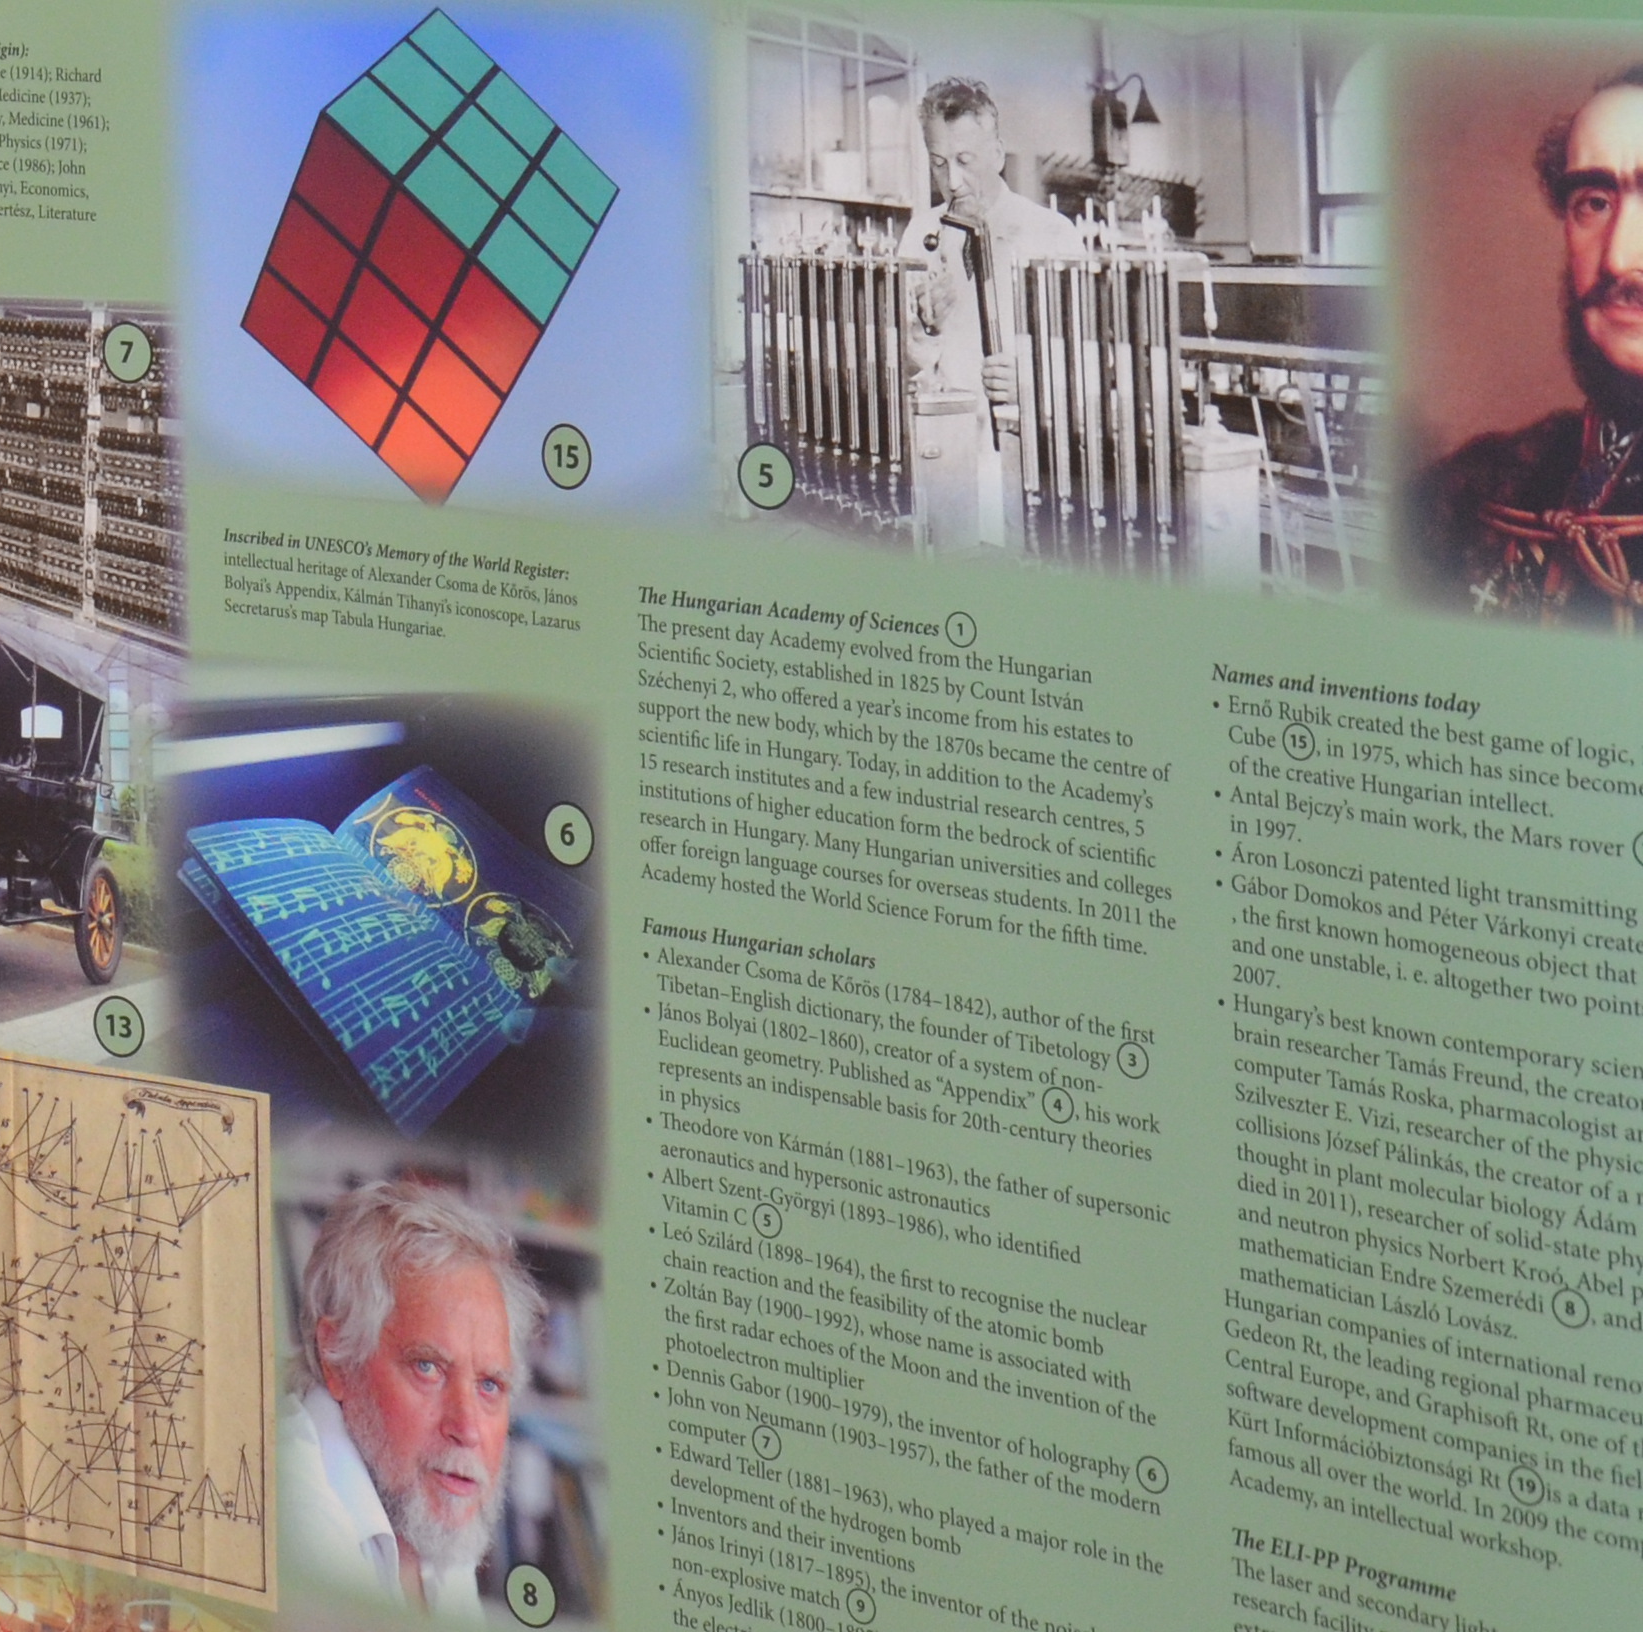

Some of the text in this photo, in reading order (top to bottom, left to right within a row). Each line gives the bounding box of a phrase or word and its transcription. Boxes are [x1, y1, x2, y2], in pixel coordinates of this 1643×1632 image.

[120, 340, 134, 364] 7
[553, 443, 579, 469] 15
[758, 463, 774, 488] 5
[223, 527, 285, 548] Inscribed
[287, 534, 301, 550] in
[375, 543, 431, 568] Memory
[432, 550, 446, 570] of
[448, 551, 469, 568] the
[473, 554, 511, 573] World
[513, 558, 570, 581] Register:
[223, 551, 294, 573] intellectual
[297, 557, 349, 583] heritage
[351, 563, 364, 580] of
[367, 565, 432, 588] Alexander
[435, 574, 479, 594] Csoma
[481, 578, 497, 596] de
[544, 587, 578, 607] János
[275, 580, 341, 603] Appendix,
[344, 586, 393, 608] Kálmán
[455, 601, 528, 628] iconoscope,
[531, 610, 581, 632] Lazarus
[300, 609, 329, 628] map
[331, 609, 374, 629] Tabula
[378, 614, 446, 639] Hungariae.
[638, 586, 667, 606] The
[670, 589, 762, 618] Hungarian
[766, 600, 846, 631] Academy
[848, 609, 867, 634] of
[869, 611, 940, 637] Sciences
[637, 612, 1092, 685] The present day Academy evolved from the Hungarian
[638, 640, 1084, 712] Scientific Society, established in 1825 by Count István
[1211, 663, 1481, 720] Names and inventions today
[1278, 700, 1333, 730] Rubik
[1337, 714, 1404, 737] created
[1409, 717, 1440, 742] the
[1446, 721, 1485, 748] best
[1490, 734, 1545, 755] game
[1550, 737, 1570, 758] of
[1577, 738, 1635, 768] logic,
[560, 822, 575, 847] 6
[1229, 785, 1279, 809] Antal
[1360, 807, 1407, 830] main
[1412, 814, 1468, 839] work,
[1473, 819, 1505, 842] the
[1511, 824, 1563, 850] Mars
[1568, 837, 1625, 858] rover
[642, 916, 876, 970] Famous Hungarian scholars
[657, 947, 741, 976] Alexander
[745, 959, 803, 987] Csoma
[807, 969, 827, 990] de
[1001, 1004, 1062, 1029] author
[1065, 1013, 1084, 1034] of
[1087, 1015, 1117, 1038] the
[1120, 1020, 1156, 1048] first
[105, 1014, 132, 1039] 13
[659, 1084, 741, 1115] in physics
[660, 1144, 991, 1219] aeronautics and hypersonic astronautics
[662, 1193, 729, 1223] Vitamin
[733, 1207, 747, 1227] C
[665, 1332, 865, 1391] photoelectron multiplier
[668, 1419, 747, 1448] computer
[671, 1496, 916, 1574] Inventors and their inventions
[1231, 1526, 1457, 1603] The ELI-PP Programme
[523, 1582, 538, 1607] 8
